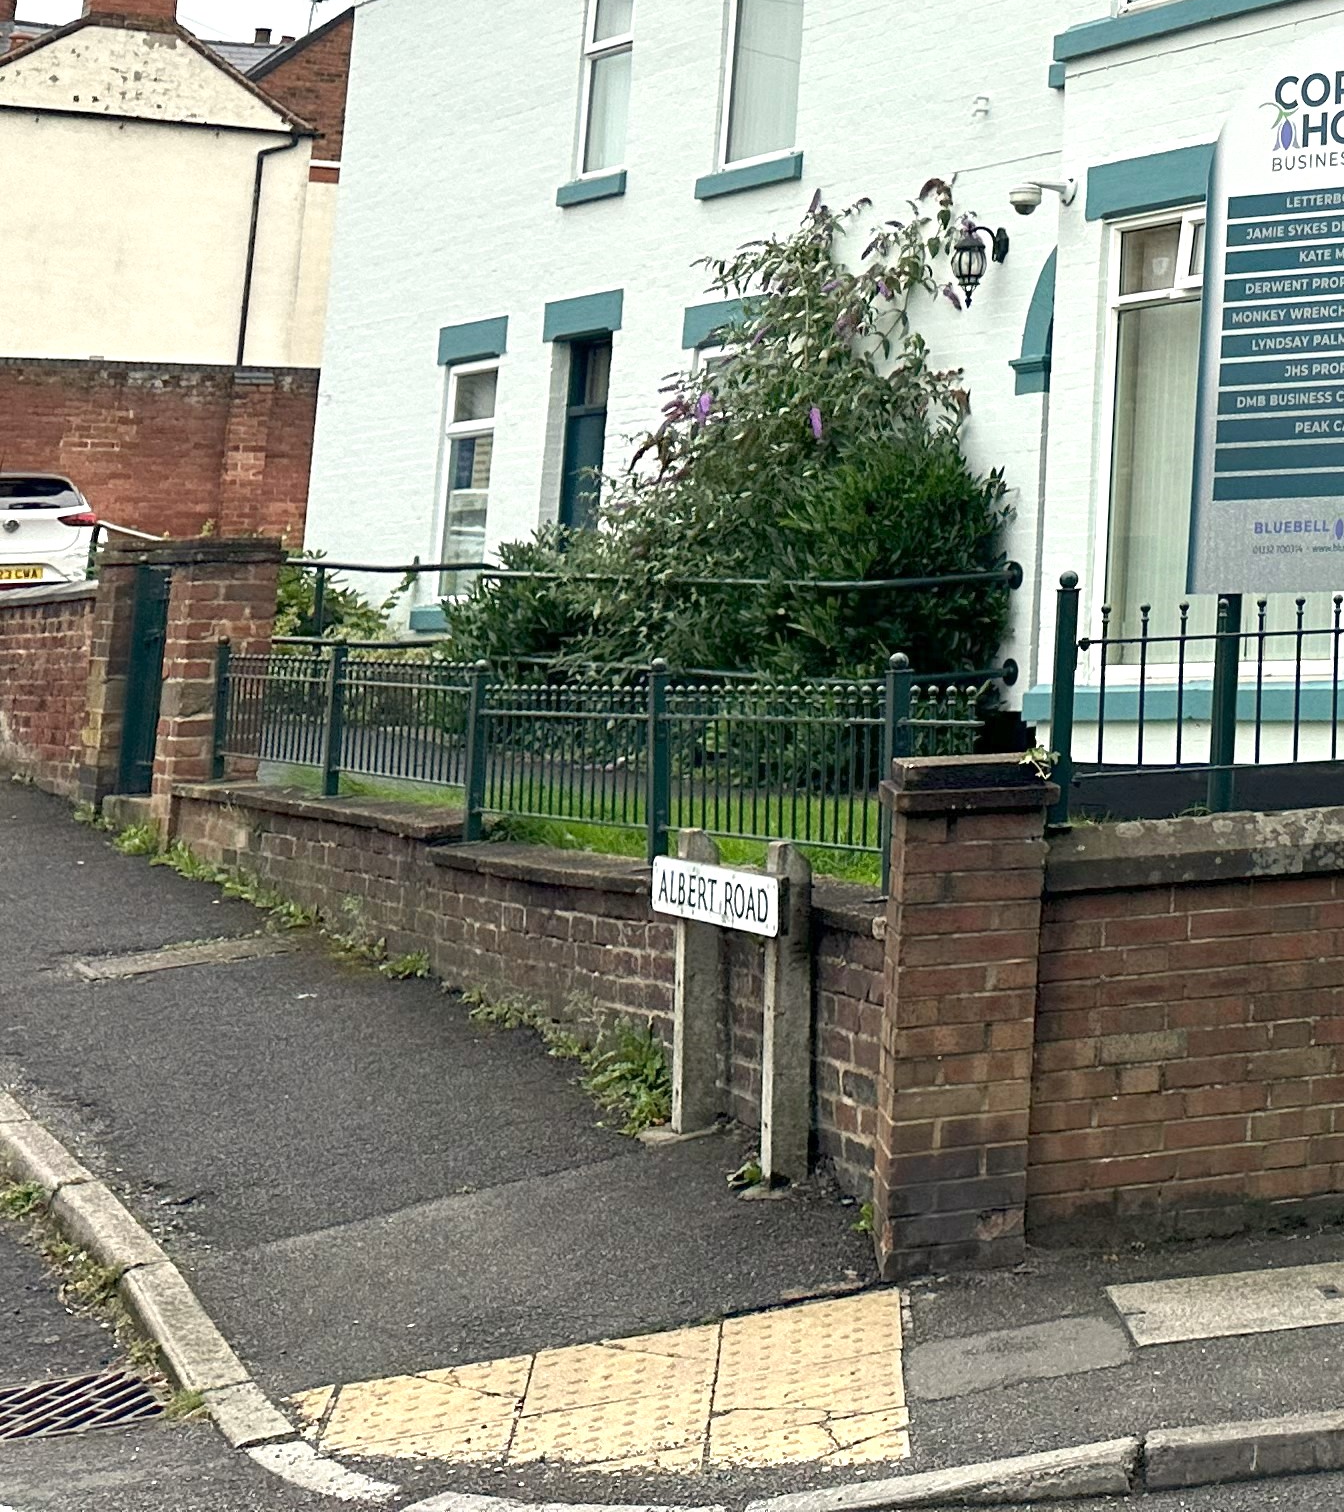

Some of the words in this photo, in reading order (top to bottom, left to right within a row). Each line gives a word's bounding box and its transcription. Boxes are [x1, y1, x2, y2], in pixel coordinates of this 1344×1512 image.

[1246, 226, 1285, 240] JAMIE
[1287, 222, 1328, 236] SYKES
[1299, 249, 1331, 262] KATE
[1245, 279, 1308, 295] DERWENT
[1231, 309, 1286, 324] MONKEY
[1251, 335, 1310, 351] LYNDSAY
[1284, 365, 1308, 377] JHS
[1236, 395, 1265, 408] DMB
[1269, 391, 1332, 406] BUSINESS
[1295, 420, 1329, 434] PEAK
[1254, 520, 1330, 534] BLUEBELL
[658, 869, 717, 912] ALBERT
[724, 881, 768, 922] ROAD
